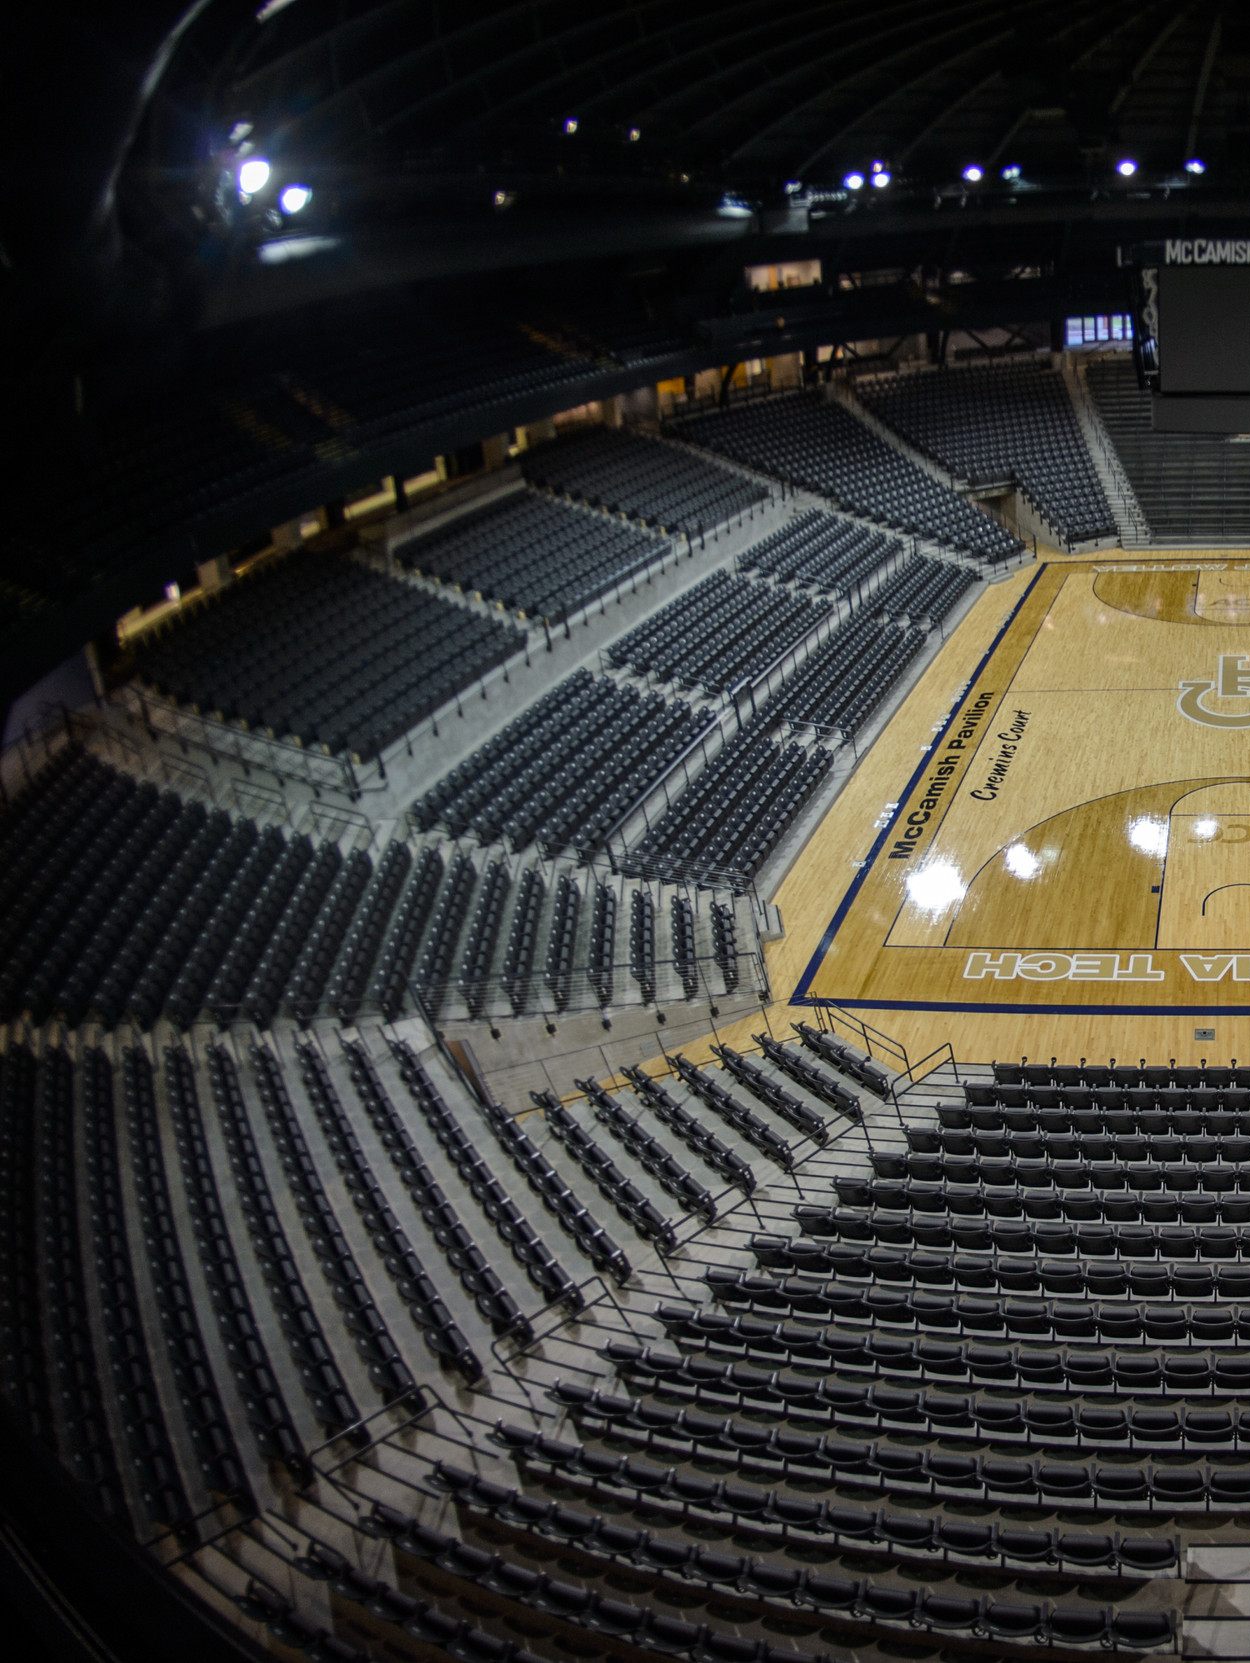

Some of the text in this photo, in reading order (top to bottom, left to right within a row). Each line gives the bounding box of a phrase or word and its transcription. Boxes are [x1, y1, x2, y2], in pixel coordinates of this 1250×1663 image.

[1092, 563, 1228, 573] YELLOW
[888, 691, 995, 860] McCamish Pavilion
[970, 709, 1032, 801] Cremins Court
[963, 952, 1164, 981] TECH
